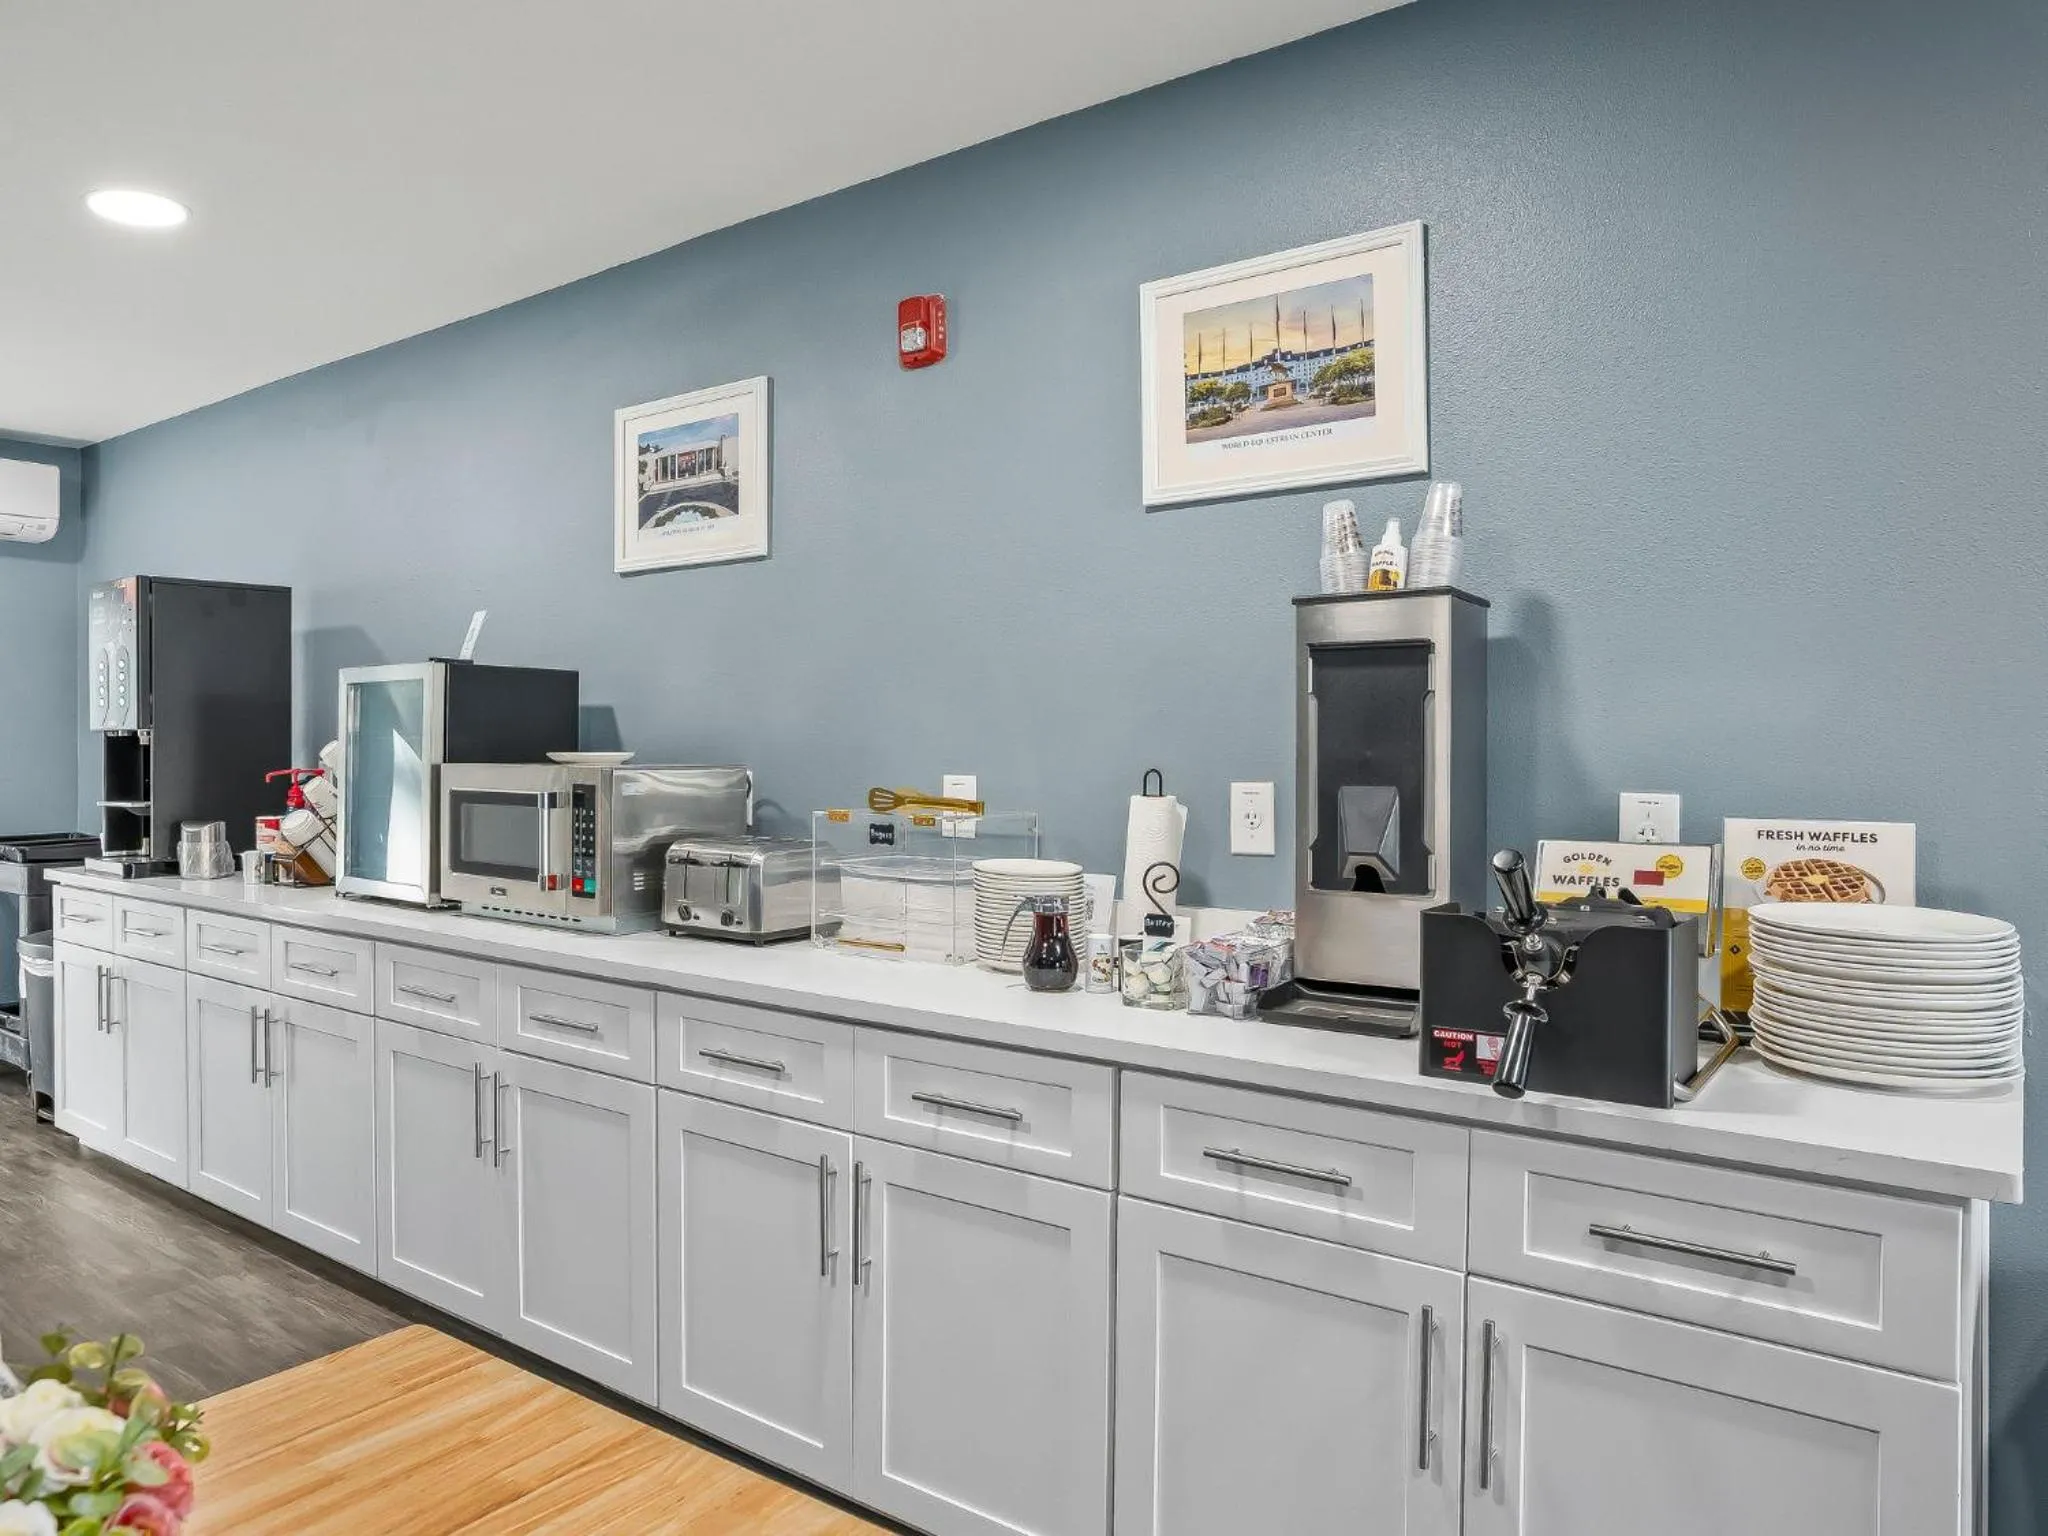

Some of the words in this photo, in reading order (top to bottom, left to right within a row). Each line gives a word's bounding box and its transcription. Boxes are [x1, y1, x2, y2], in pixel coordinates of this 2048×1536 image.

[1221, 440, 1250, 450] WORLD
[1251, 432, 1300, 447] EQUESTRIAN
[1300, 427, 1334, 439] CENTER
[1757, 829, 1804, 841] FRESH
[1808, 831, 1879, 844] WAFFLES
[1796, 843, 1807, 852] in
[1822, 843, 1846, 853] time
[1562, 852, 1613, 866] GOLDEN
[1552, 874, 1620, 887] WAFFLES
[1433, 1030, 1474, 1041] CAUTION
[1443, 1040, 1463, 1049] HOT
